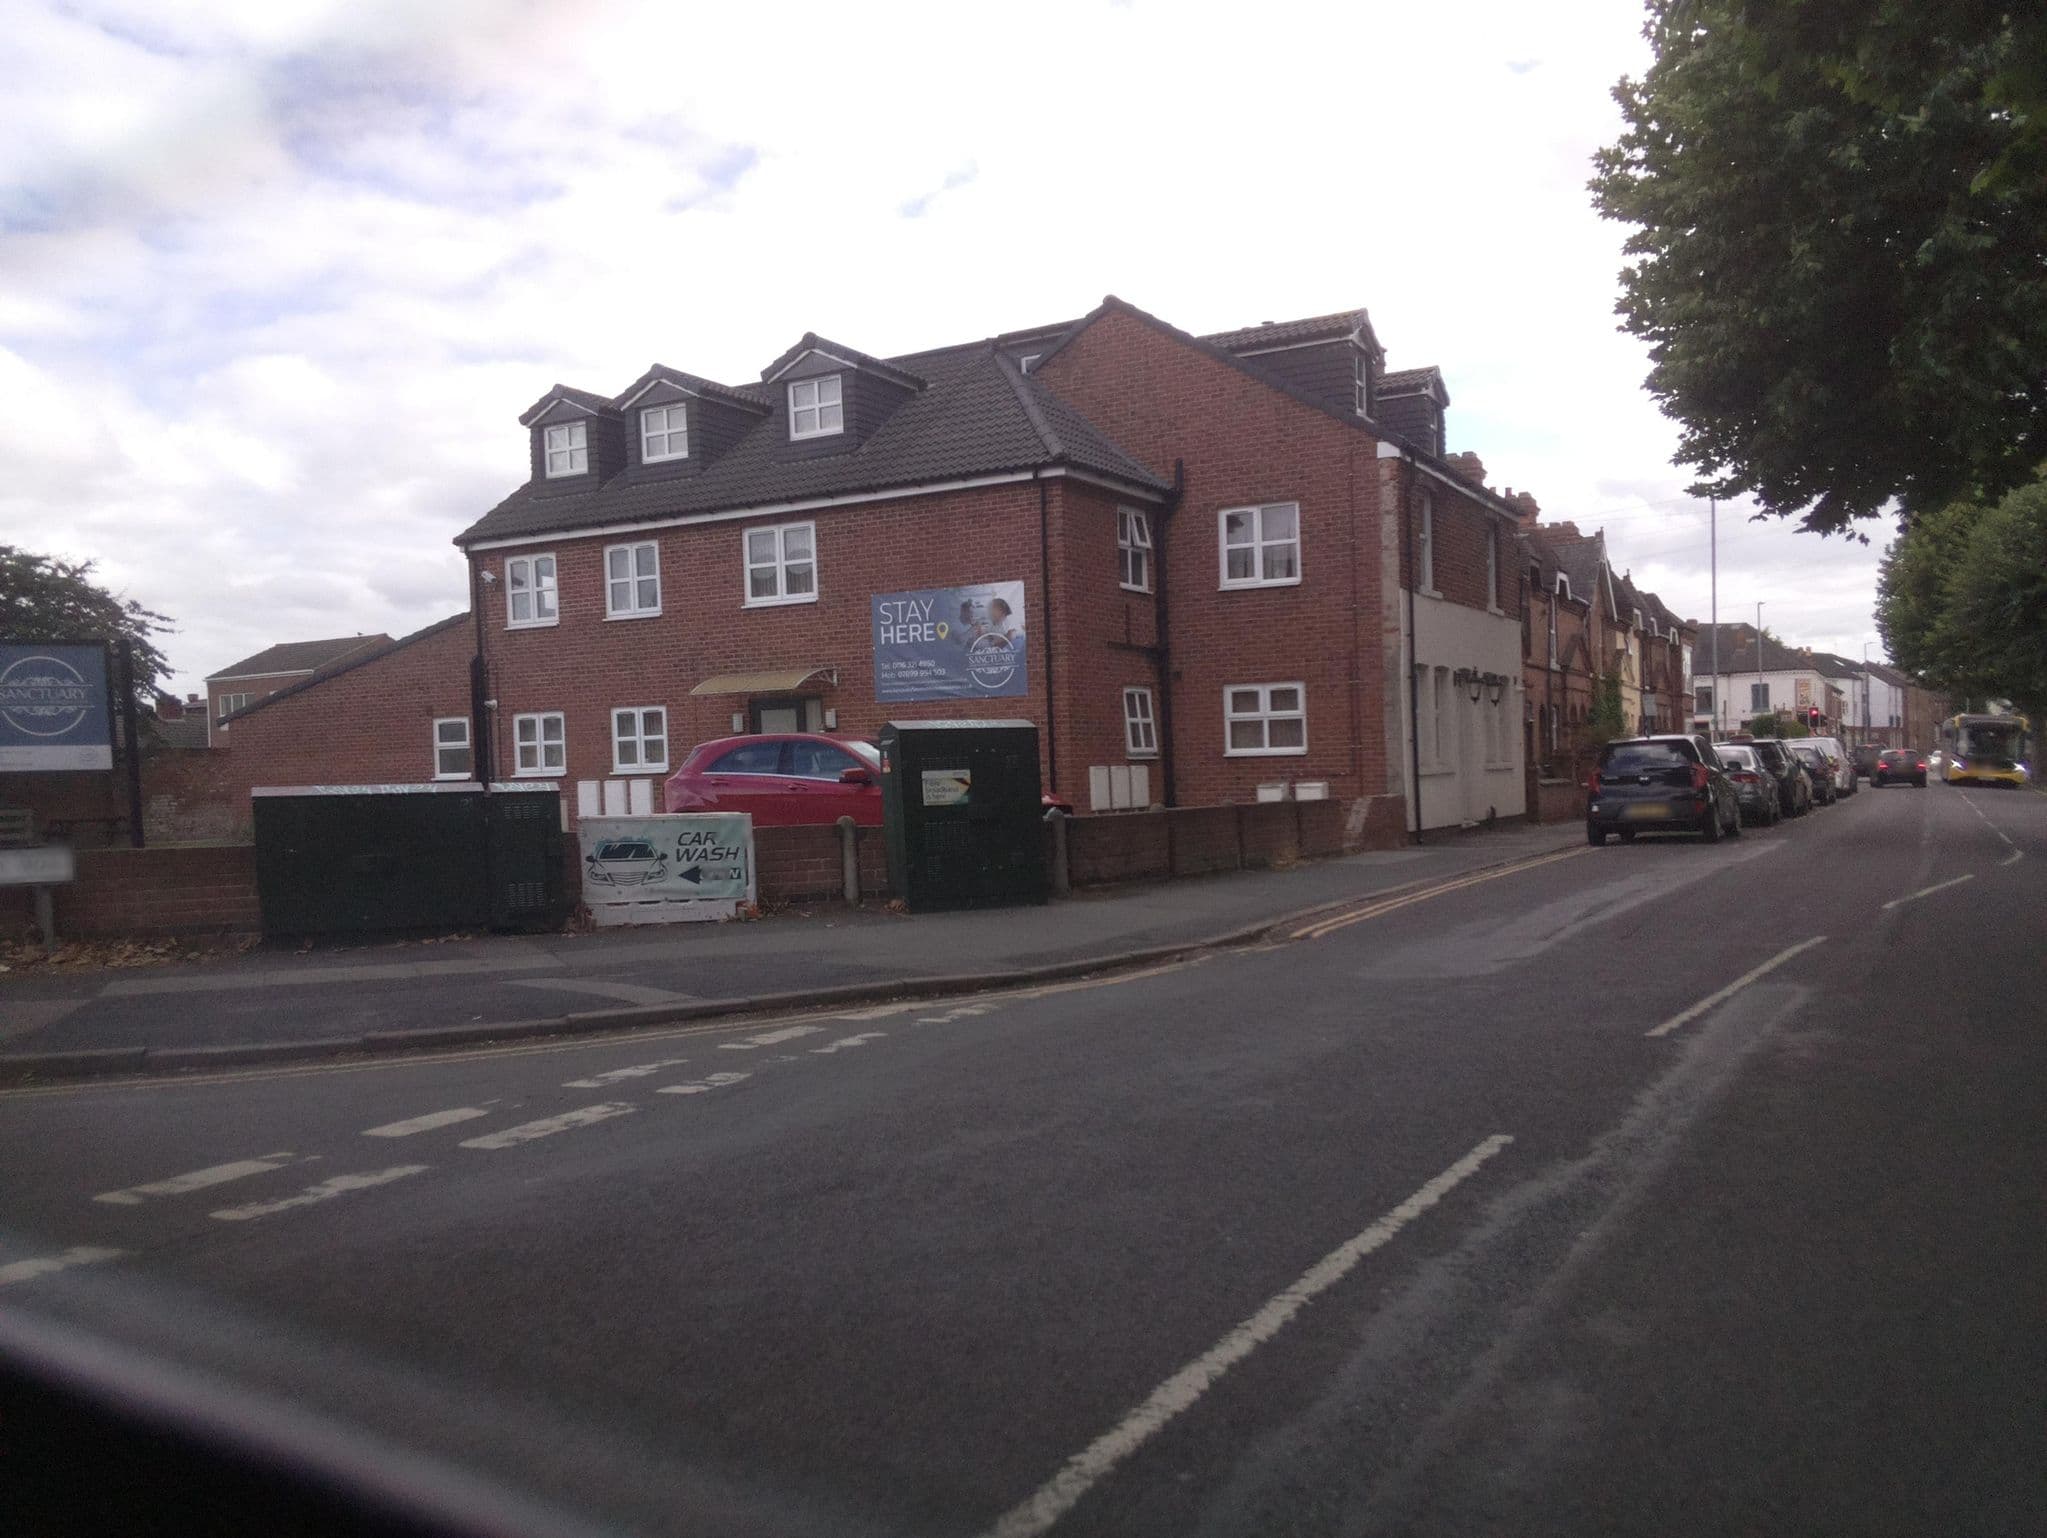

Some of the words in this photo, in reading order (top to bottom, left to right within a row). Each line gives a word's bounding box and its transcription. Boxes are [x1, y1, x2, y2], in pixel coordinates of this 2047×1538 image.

[879, 598, 934, 625] STAY
[880, 622, 936, 645] HERE
[968, 653, 1016, 665] SANCTUARY
[678, 831, 717, 846] CAR
[676, 847, 740, 863] WASH
